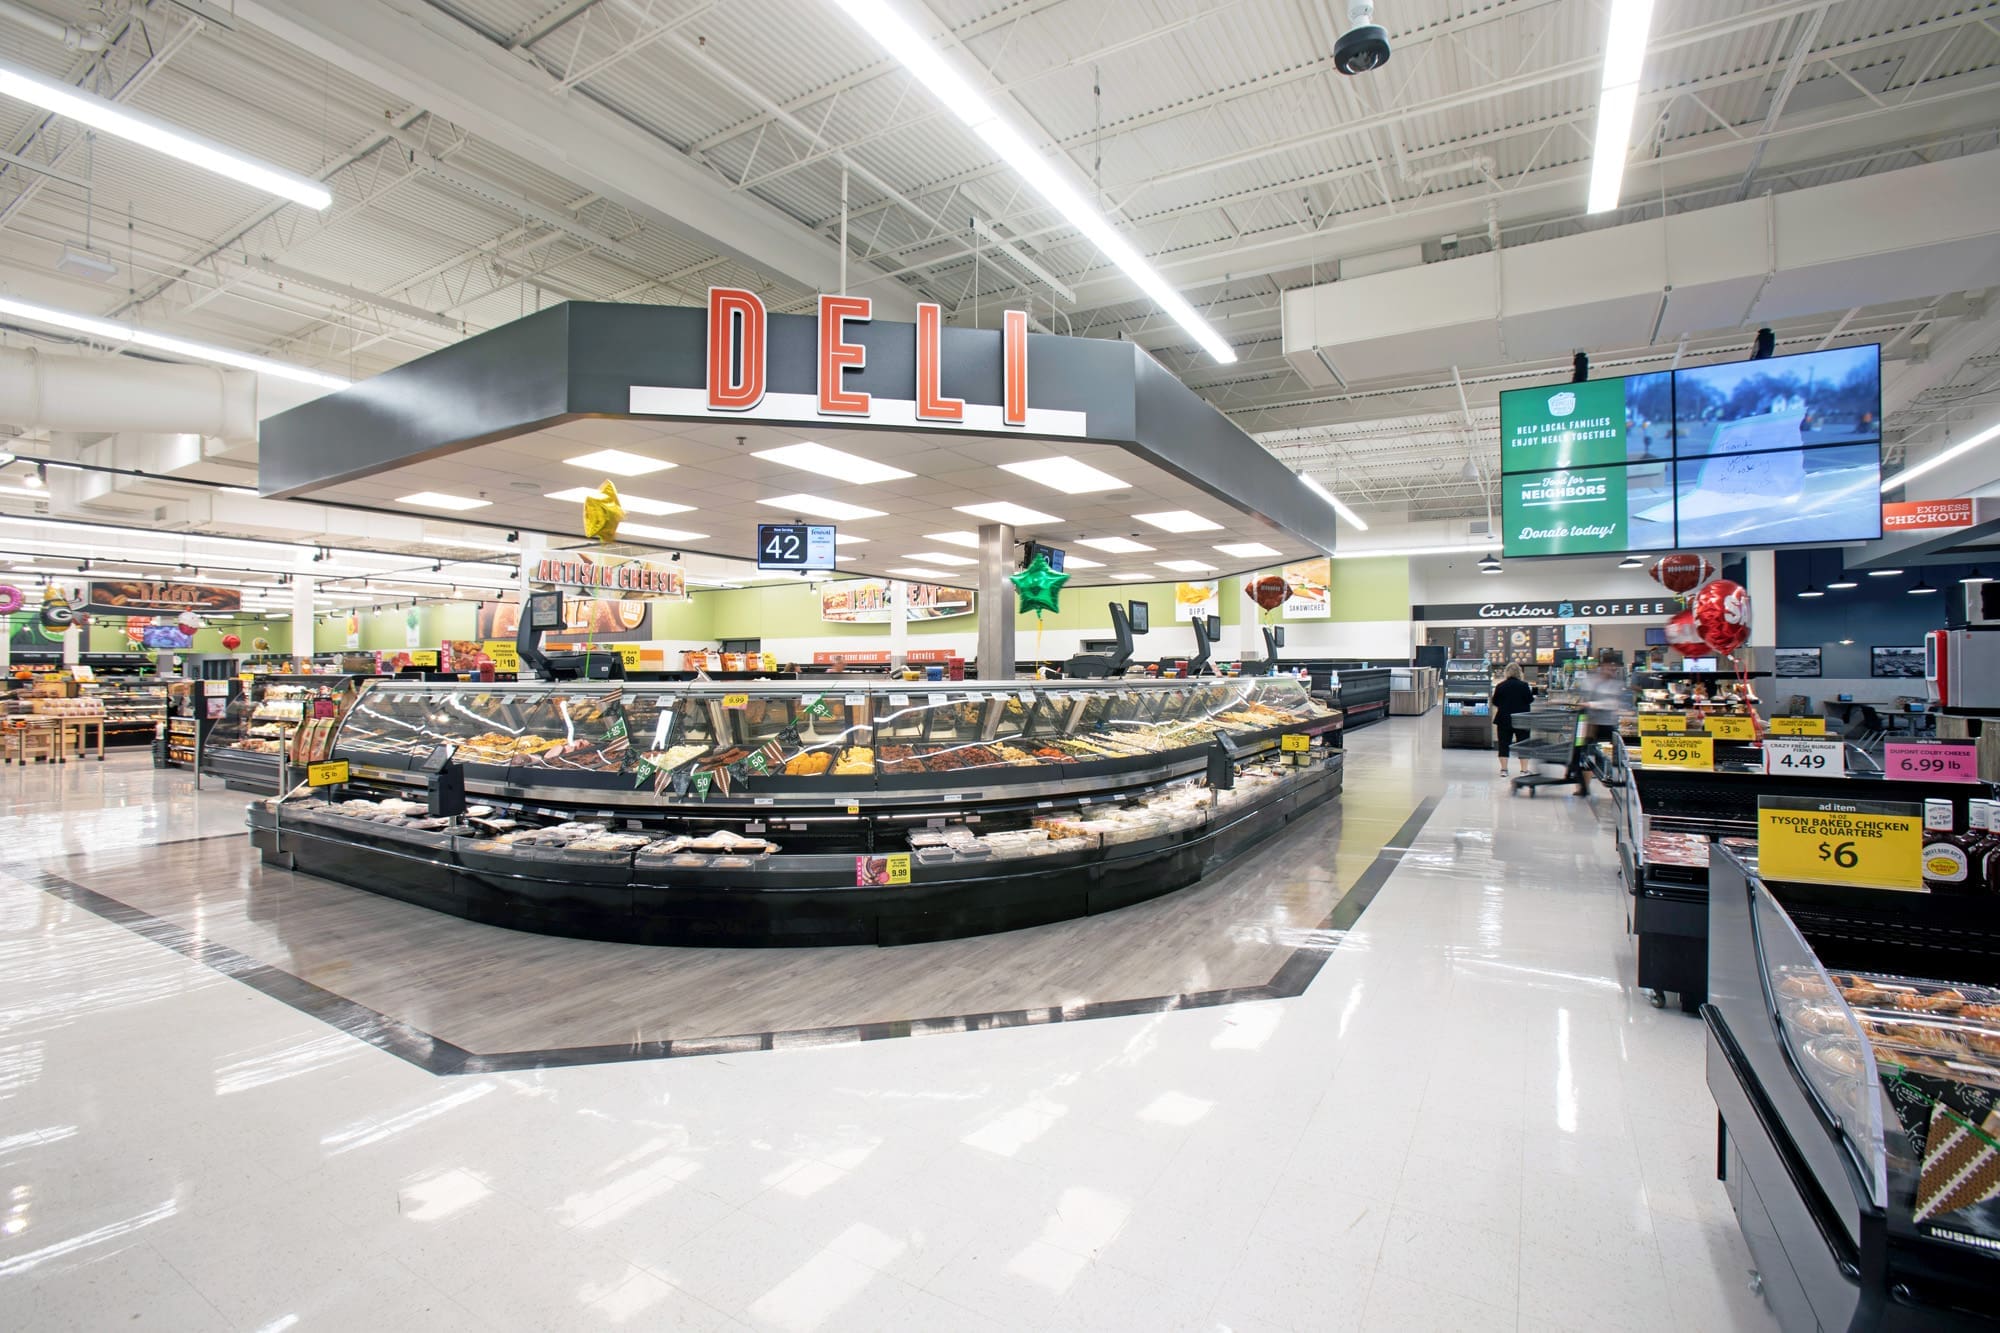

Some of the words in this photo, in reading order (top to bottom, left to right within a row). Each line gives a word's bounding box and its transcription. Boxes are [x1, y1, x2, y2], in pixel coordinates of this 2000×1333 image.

[707, 286, 1028, 425] DELI
[1517, 425, 1538, 435] HELP
[1541, 422, 1566, 432] LOCAL
[1570, 417, 1610, 429] FAMILIES
[1512, 437, 1538, 447] ENJOY
[1541, 434, 1570, 444] MEAL
[1572, 429, 1616, 440] TOGETHER
[1542, 477, 1567, 487] Food
[1567, 476, 1584, 486] for
[1521, 484, 1606, 500] NEIGHBORS
[1917, 503, 1969, 514] EXPRESS
[1885, 511, 1970, 525] CHECKOUT
[1518, 526, 1569, 540] Donate
[1570, 523, 1616, 539] today!
[765, 535, 800, 559] 42
[538, 559, 613, 587] ARTISAN
[619, 566, 678, 592] CHEESE
[846, 588, 885, 610] HEAT
[908, 583, 938, 607] EAT
[1289, 604, 1325, 612] SANDWICHES
[1479, 604, 1554, 618] Caribou
[1580, 603, 1665, 616] COFFEE
[1653, 749, 1688, 760] 4.99
[1691, 750, 1700, 759] lb
[1780, 754, 1825, 768] 4.49
[1901, 758, 1944, 772] 6.99
[1948, 760, 1961, 769] lb
[1819, 803, 1832, 811] ad
[1834, 803, 1856, 812] item
[1770, 816, 1808, 825] TYSON
[1812, 818, 1852, 828] BAKED
[1855, 820, 1909, 831] CHICKEN
[1794, 825, 1816, 834] LEG
[1820, 826, 1883, 838] QUARTERS
[1818, 841, 1858, 868] $6
[892, 869, 907, 877] 9.99
